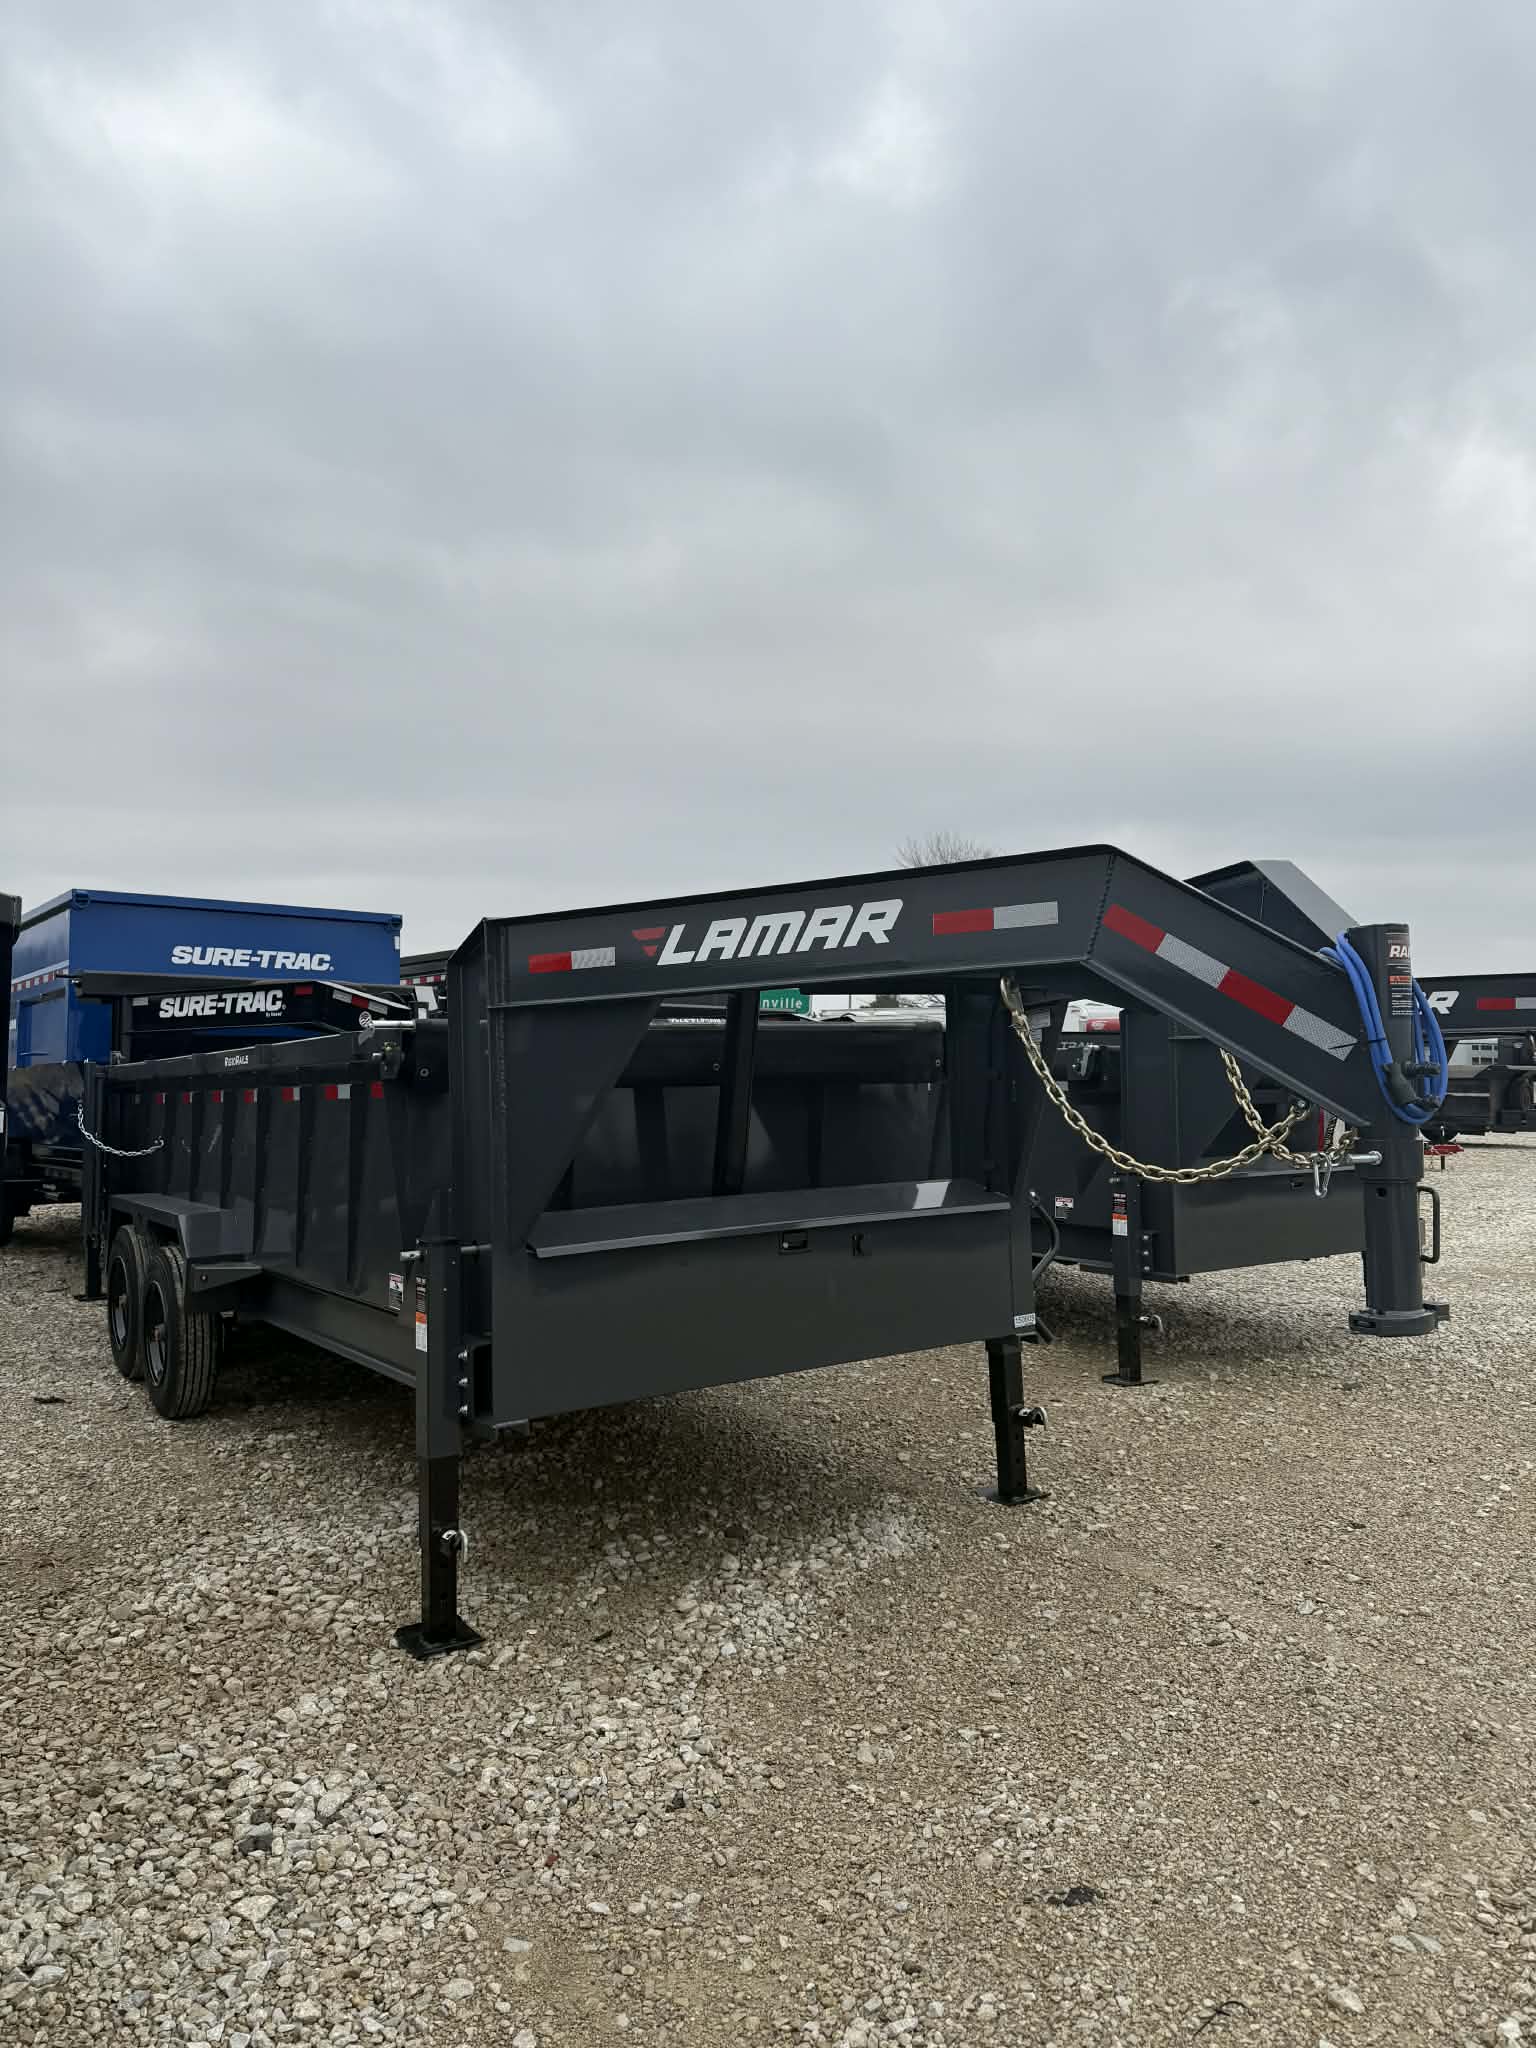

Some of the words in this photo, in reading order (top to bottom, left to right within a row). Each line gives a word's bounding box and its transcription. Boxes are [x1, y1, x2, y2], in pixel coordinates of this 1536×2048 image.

[656, 898, 904, 966] LAMAR
[171, 945, 331, 971] SURE-TRAC
[159, 989, 284, 1018] SURE-TRAC
[760, 997, 803, 1009] nville
